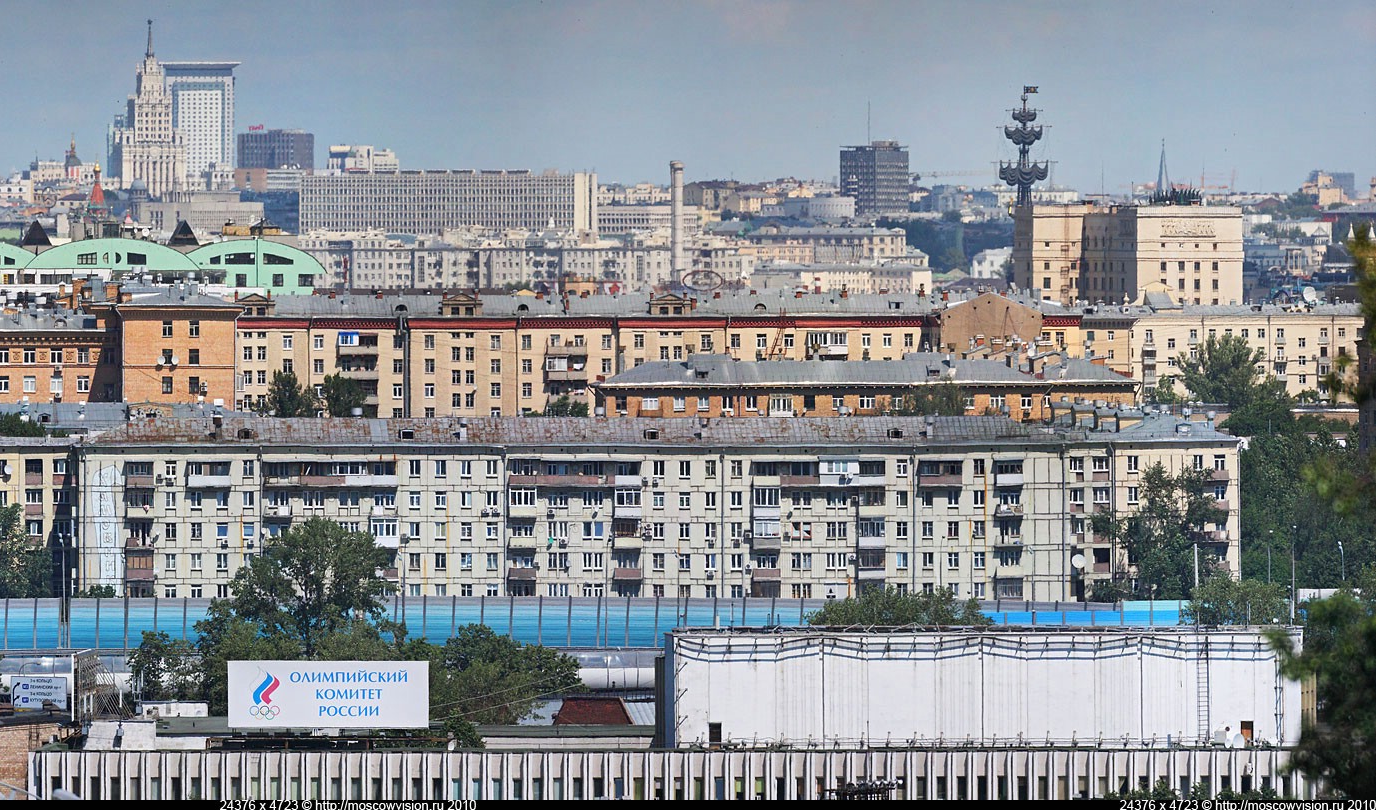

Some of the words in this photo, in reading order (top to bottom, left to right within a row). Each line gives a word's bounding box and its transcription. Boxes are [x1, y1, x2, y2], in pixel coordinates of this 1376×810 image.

[289, 669, 408, 683] ОЛИМПИЙСКИЙ
[315, 688, 383, 700] КОМИТЕТ
[318, 705, 380, 717] РОССИИ
